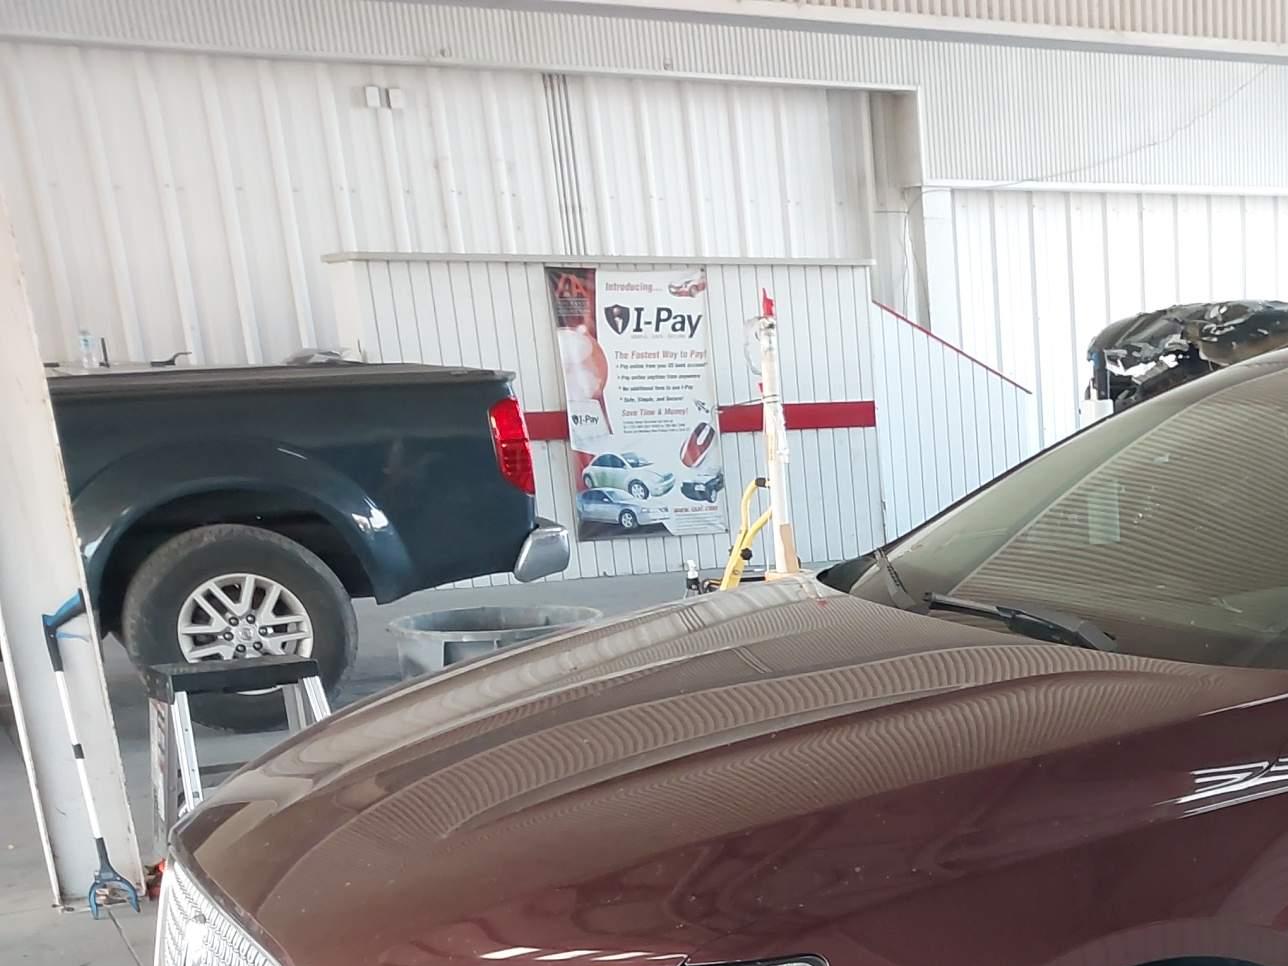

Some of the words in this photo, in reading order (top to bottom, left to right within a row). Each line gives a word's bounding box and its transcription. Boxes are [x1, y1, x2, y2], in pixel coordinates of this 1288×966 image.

[632, 306, 703, 338] I-Pay
[614, 351, 629, 360] The
[631, 350, 660, 360] Fastest
[662, 350, 677, 360] Way
[622, 409, 638, 417] Save
[579, 415, 600, 425] I-Pay
